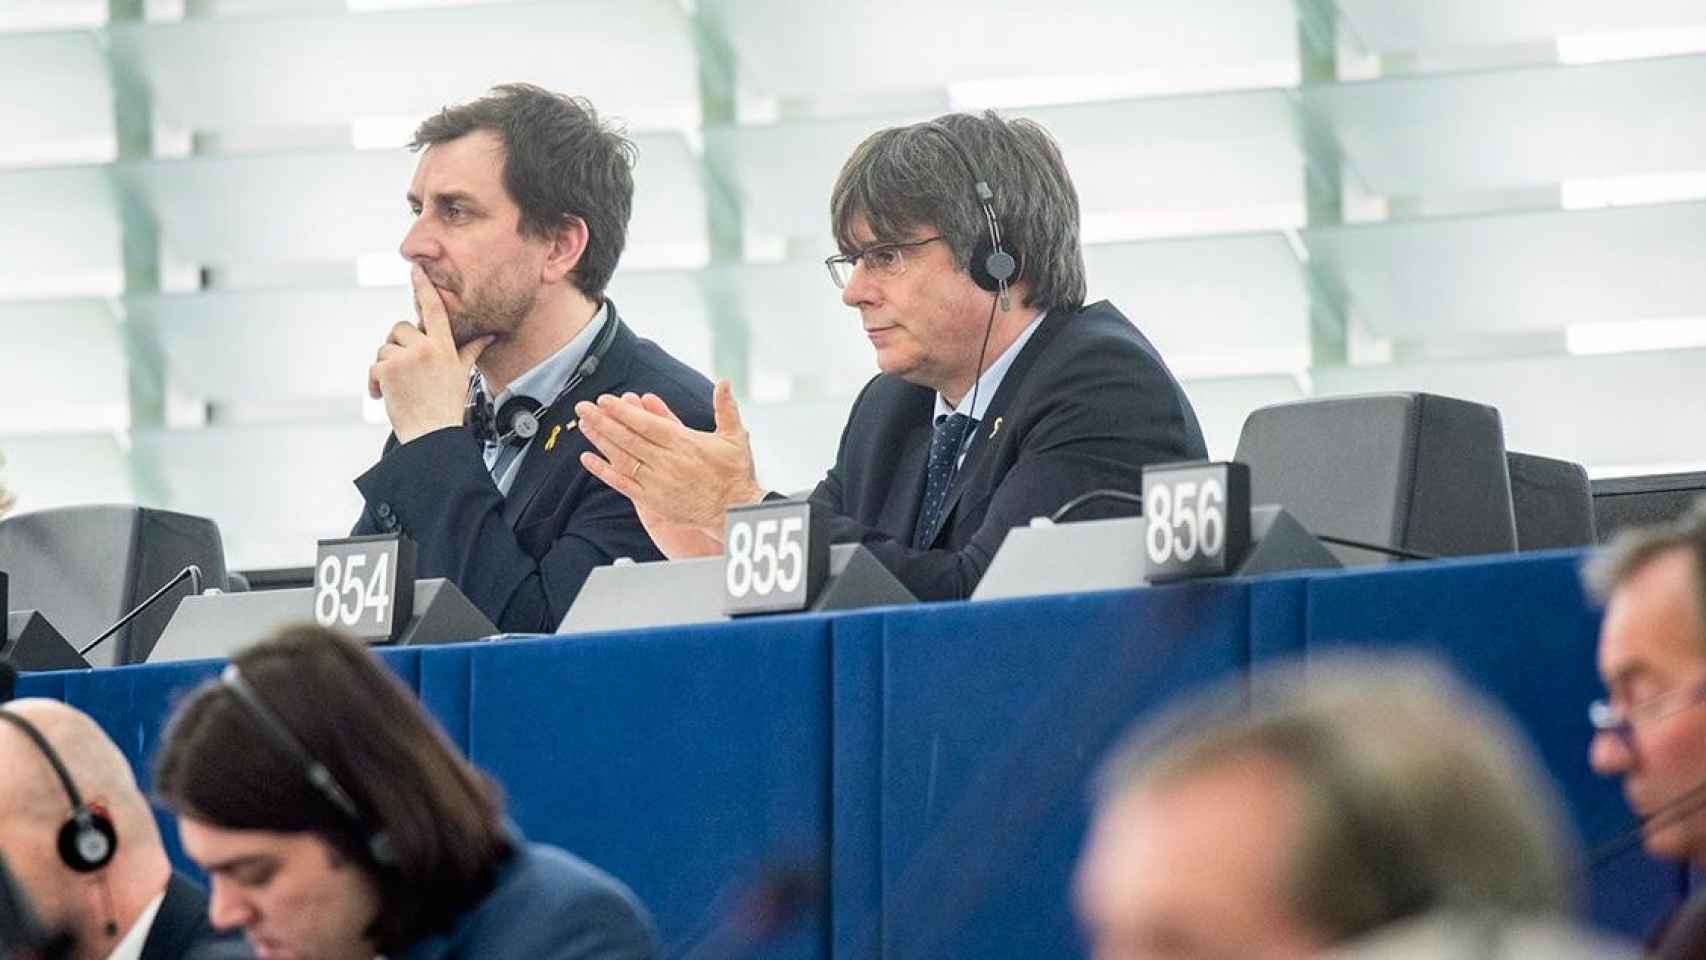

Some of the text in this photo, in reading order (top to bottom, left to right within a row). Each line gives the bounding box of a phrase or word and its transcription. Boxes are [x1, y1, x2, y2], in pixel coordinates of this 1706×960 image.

[726, 519, 801, 596] 855
[1146, 478, 1223, 563] 856
[315, 552, 388, 626] 854
